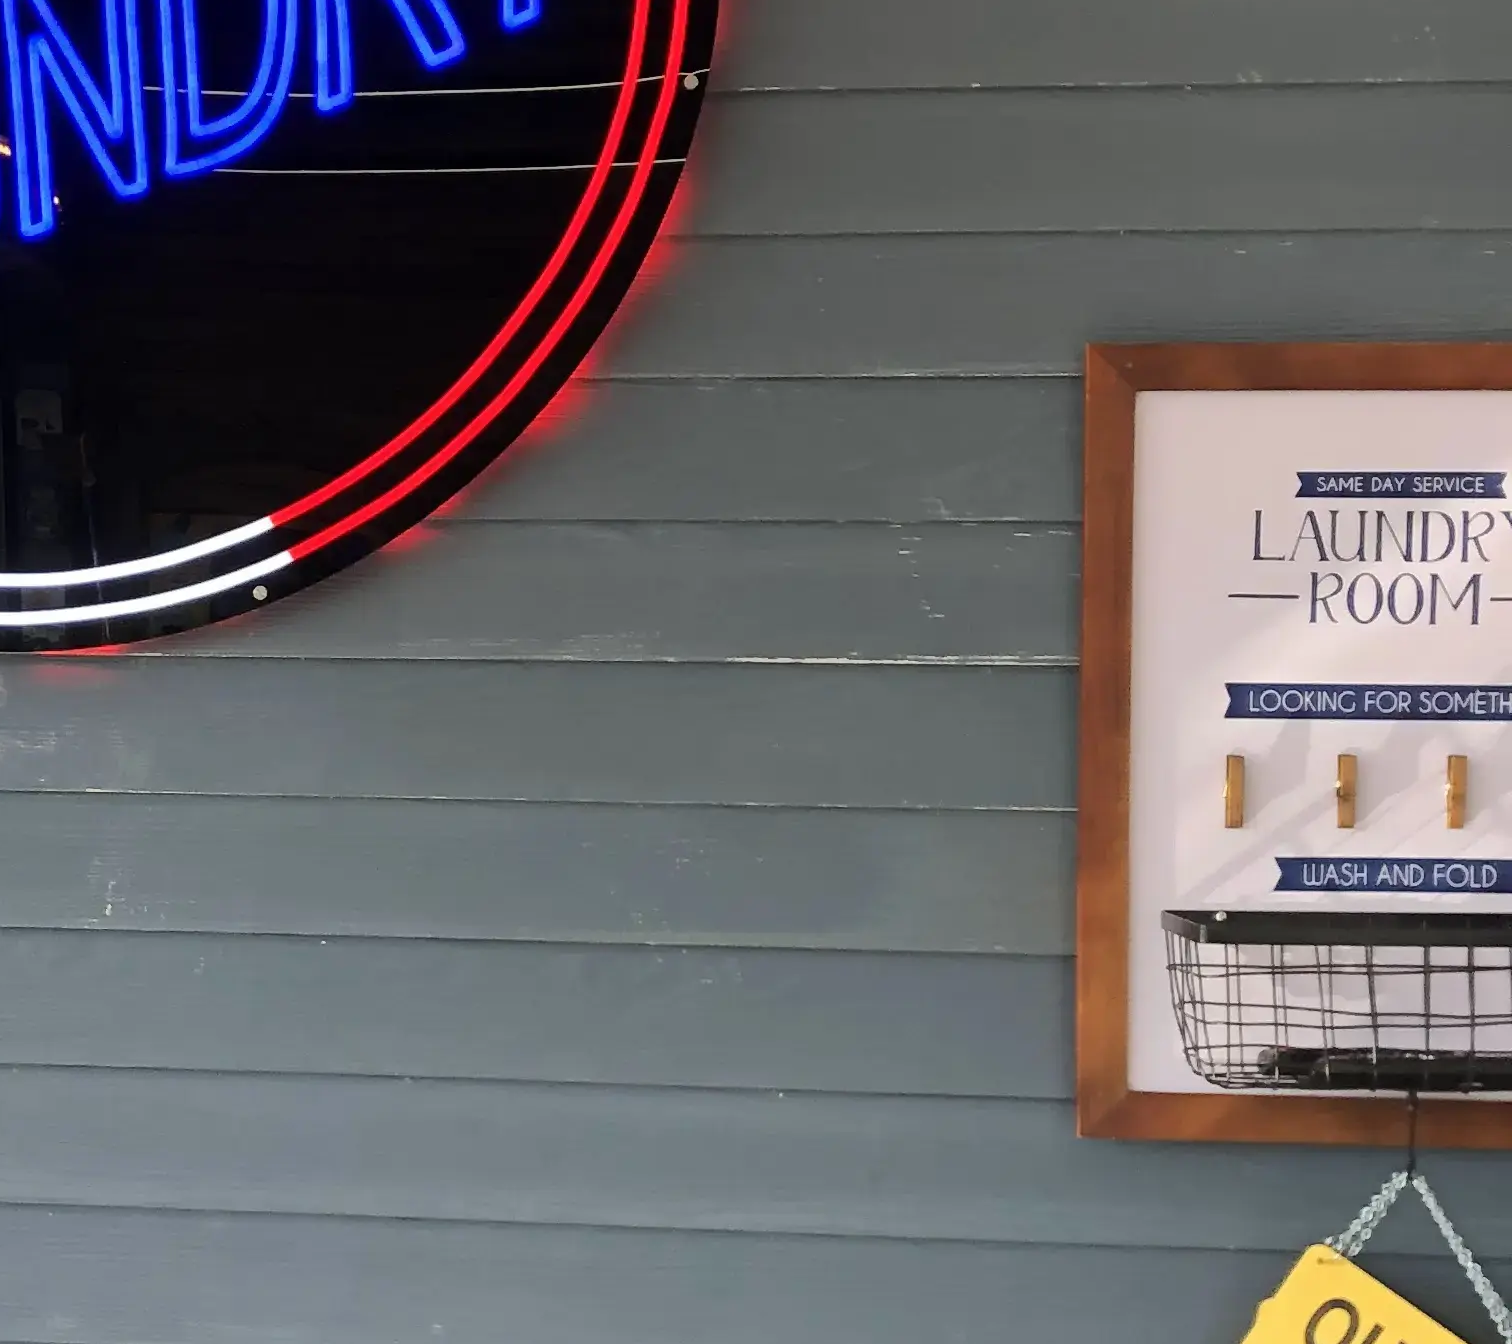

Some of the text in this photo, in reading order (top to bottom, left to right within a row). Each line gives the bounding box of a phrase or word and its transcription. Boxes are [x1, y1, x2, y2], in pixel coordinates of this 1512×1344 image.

[1316, 476, 1485, 494] SAME DAY SERVICE
[1252, 509, 1512, 563] LAUNDR
[1309, 572, 1482, 625] ROOM
[1248, 689, 1357, 713] LOOKING
[1364, 690, 1411, 713] FOR
[1303, 862, 1497, 888] WASH AND FOLD
